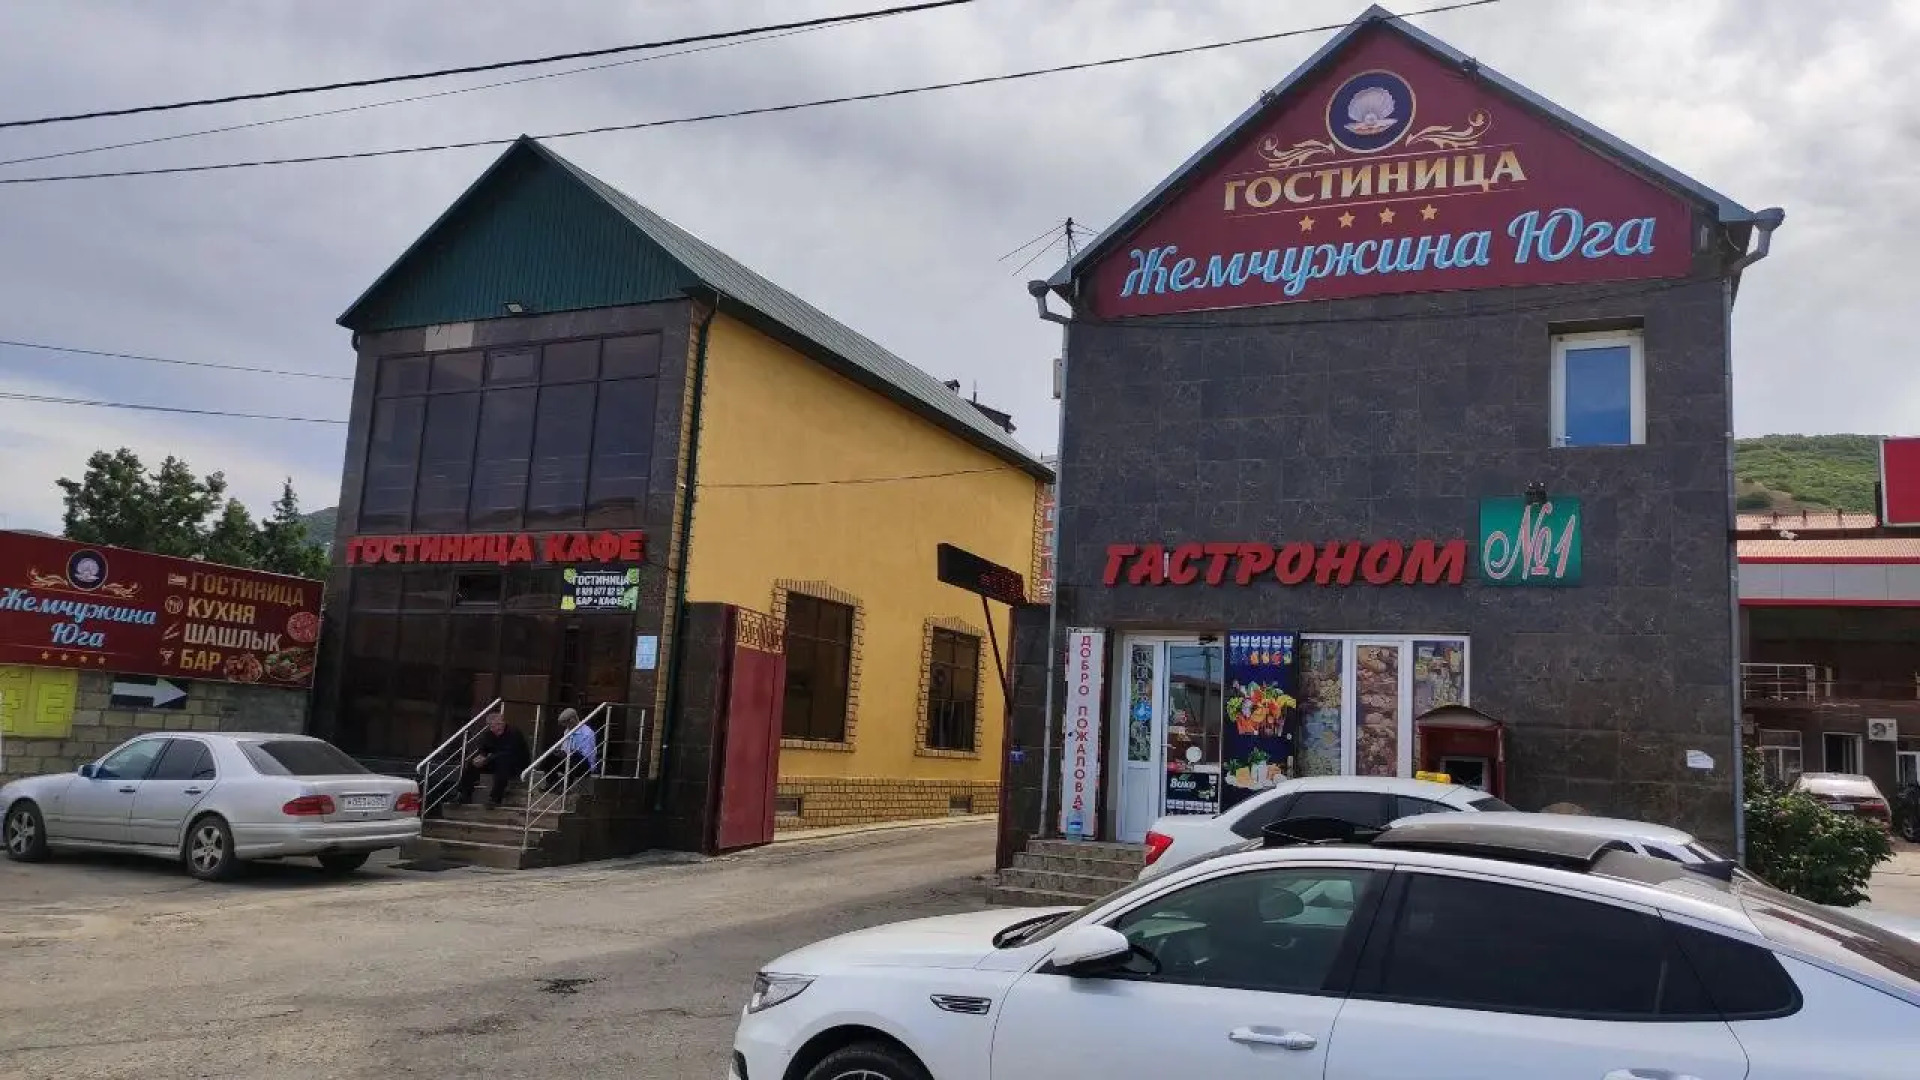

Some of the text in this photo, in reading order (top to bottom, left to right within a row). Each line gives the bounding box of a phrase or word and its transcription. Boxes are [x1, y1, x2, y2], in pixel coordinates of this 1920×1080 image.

[1223, 148, 1528, 211] ГОСТИНИЦА
[1120, 207, 1657, 297] Жемчужина Юга
[346, 530, 644, 566] ГОСТИНИЦА КАФЕ
[1483, 501, 1577, 581] №1
[572, 574, 630, 586] ГОСТИНИЦА
[1102, 539, 1467, 588] ГАСТРОНОМ
[190, 571, 305, 606] ГОСТИНИЦА
[575, 596, 593, 606] БАР
[0, 586, 157, 648] Жемчужина Юга
[186, 596, 257, 625] КУХНЯ
[182, 622, 284, 652] ШАШЛЫК
[179, 649, 223, 672] БАР
[1077, 634, 1092, 696] ДОБРО
